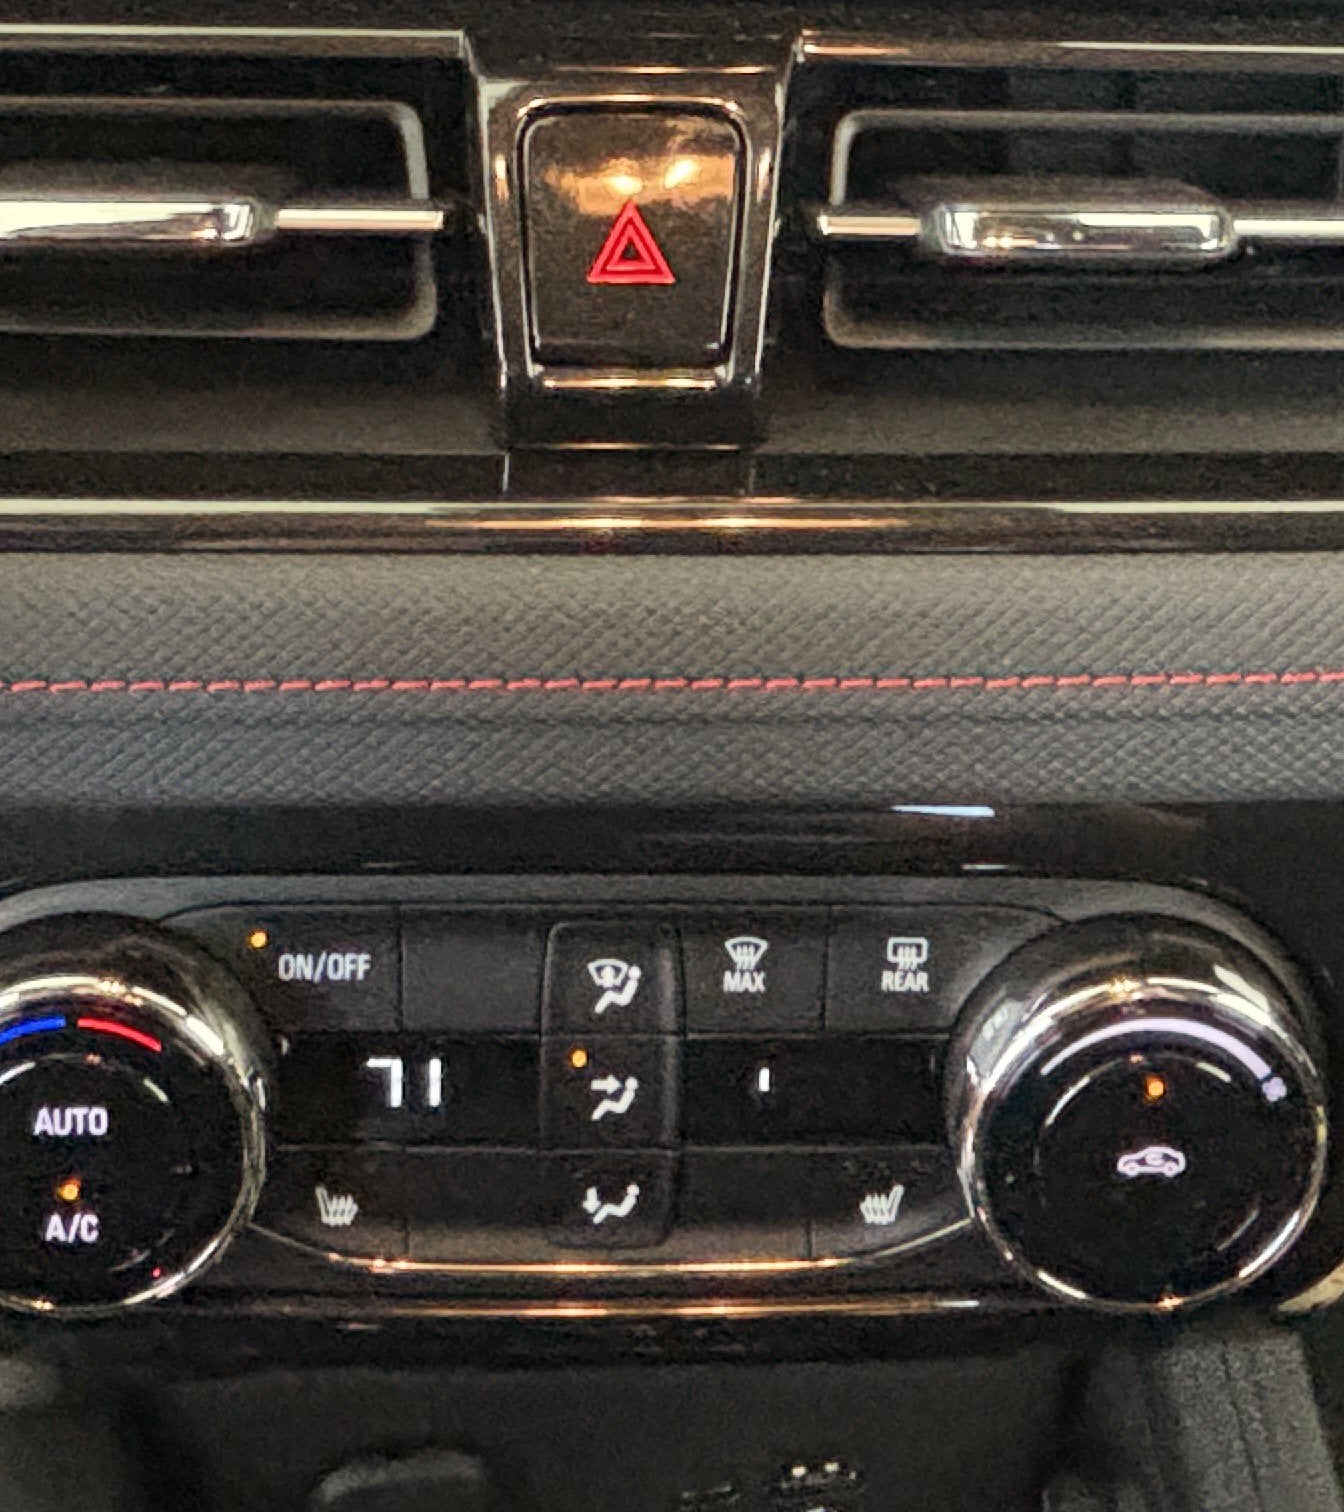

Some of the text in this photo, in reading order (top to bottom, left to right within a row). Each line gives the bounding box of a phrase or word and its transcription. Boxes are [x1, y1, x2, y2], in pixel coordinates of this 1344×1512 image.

[278, 952, 372, 983] ON/OFF
[723, 969, 766, 994] MAX
[881, 969, 930, 994] REAR
[366, 1057, 444, 1108] 71
[33, 1106, 109, 1138] AUTO
[44, 1214, 99, 1245] A/C
